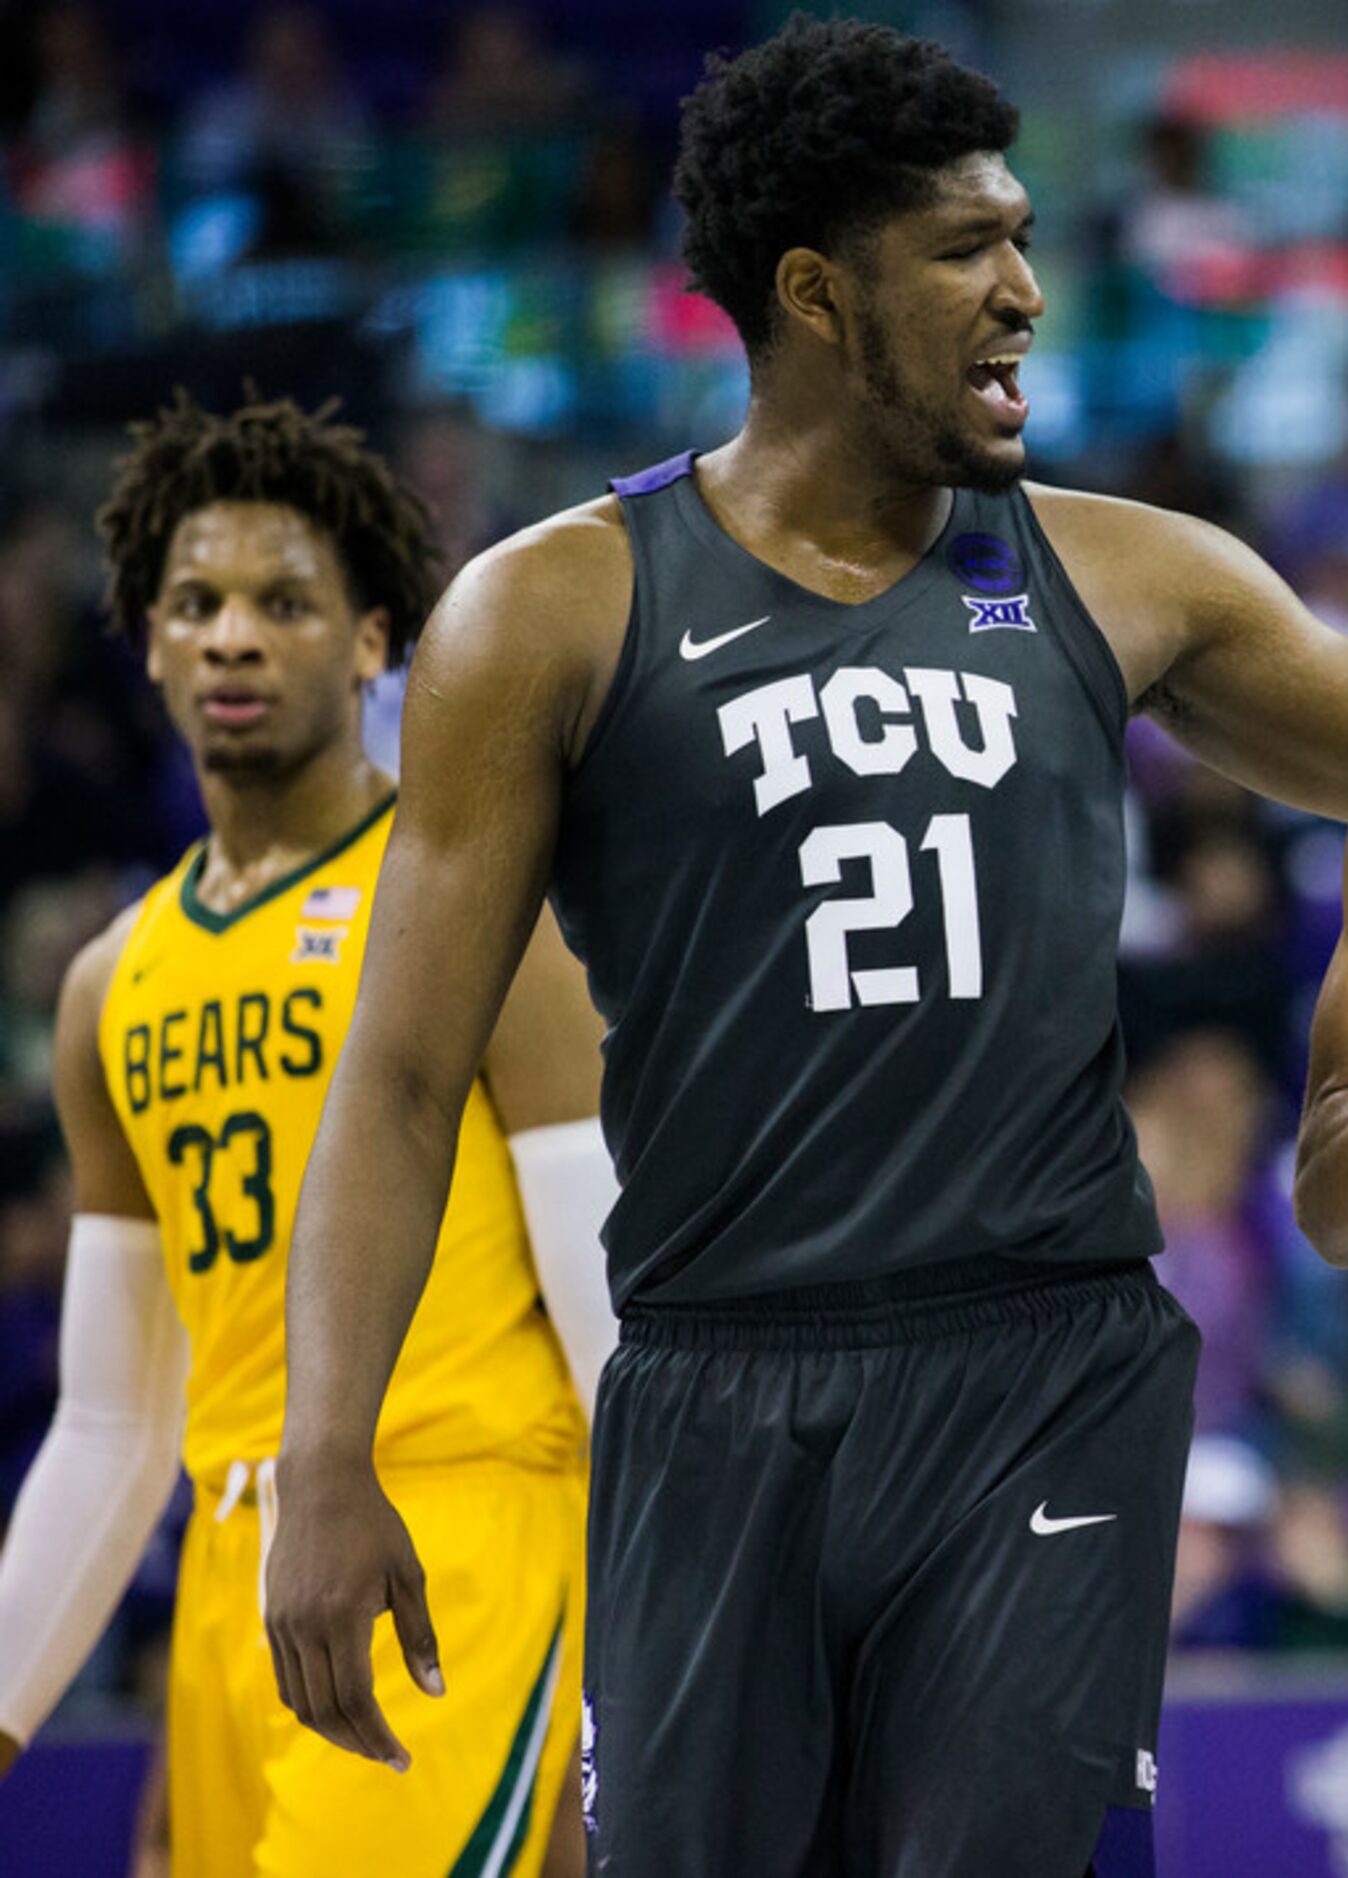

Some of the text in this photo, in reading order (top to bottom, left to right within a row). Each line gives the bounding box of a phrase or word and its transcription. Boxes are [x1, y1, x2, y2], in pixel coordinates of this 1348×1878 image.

[964, 596, 1035, 632] XII
[717, 667, 1018, 817] TCU
[799, 813, 981, 1012] 21
[126, 988, 323, 1116] BEARS
[167, 1112, 275, 1275] 33
